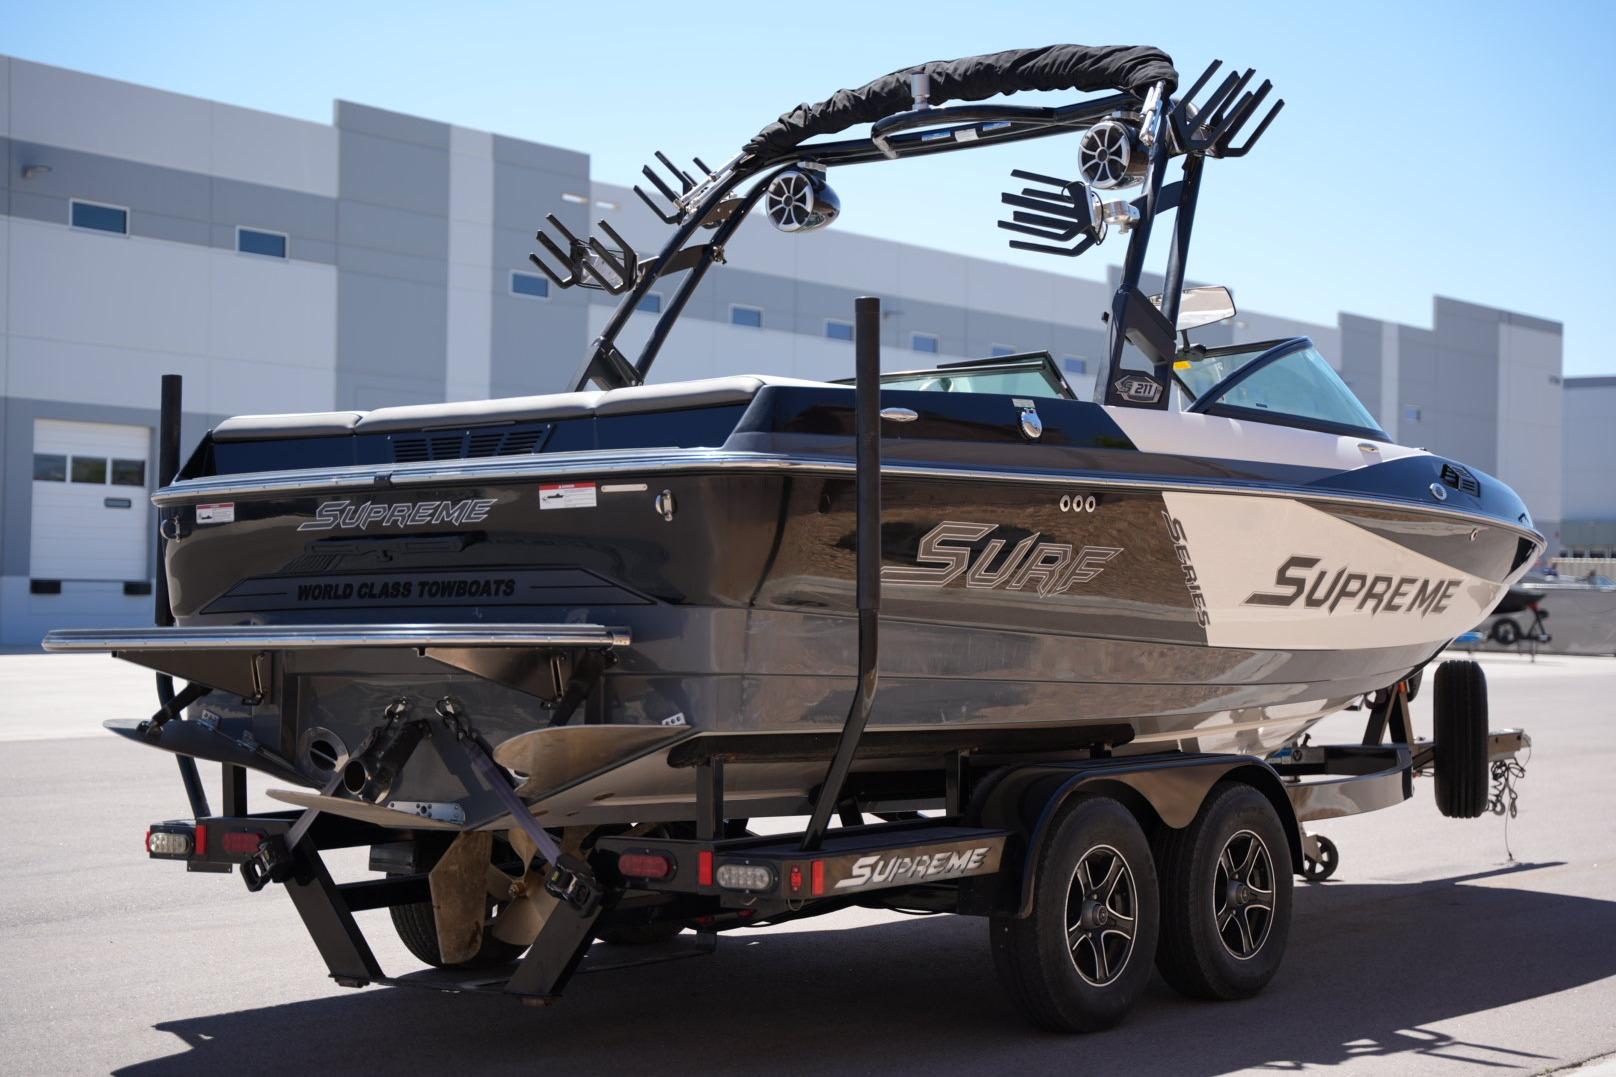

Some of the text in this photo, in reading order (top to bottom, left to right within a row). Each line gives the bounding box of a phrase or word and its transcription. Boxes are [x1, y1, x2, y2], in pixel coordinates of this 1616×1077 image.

[1135, 383, 1153, 395] 211
[297, 499, 498, 532] SUPREME
[880, 520, 1125, 599] SURF
[1161, 510, 1211, 629] SERIES
[297, 578, 516, 601] WORLD CLASS TOWBOATS
[1239, 554, 1464, 619] SUPREME
[834, 847, 992, 889] SUPREME
